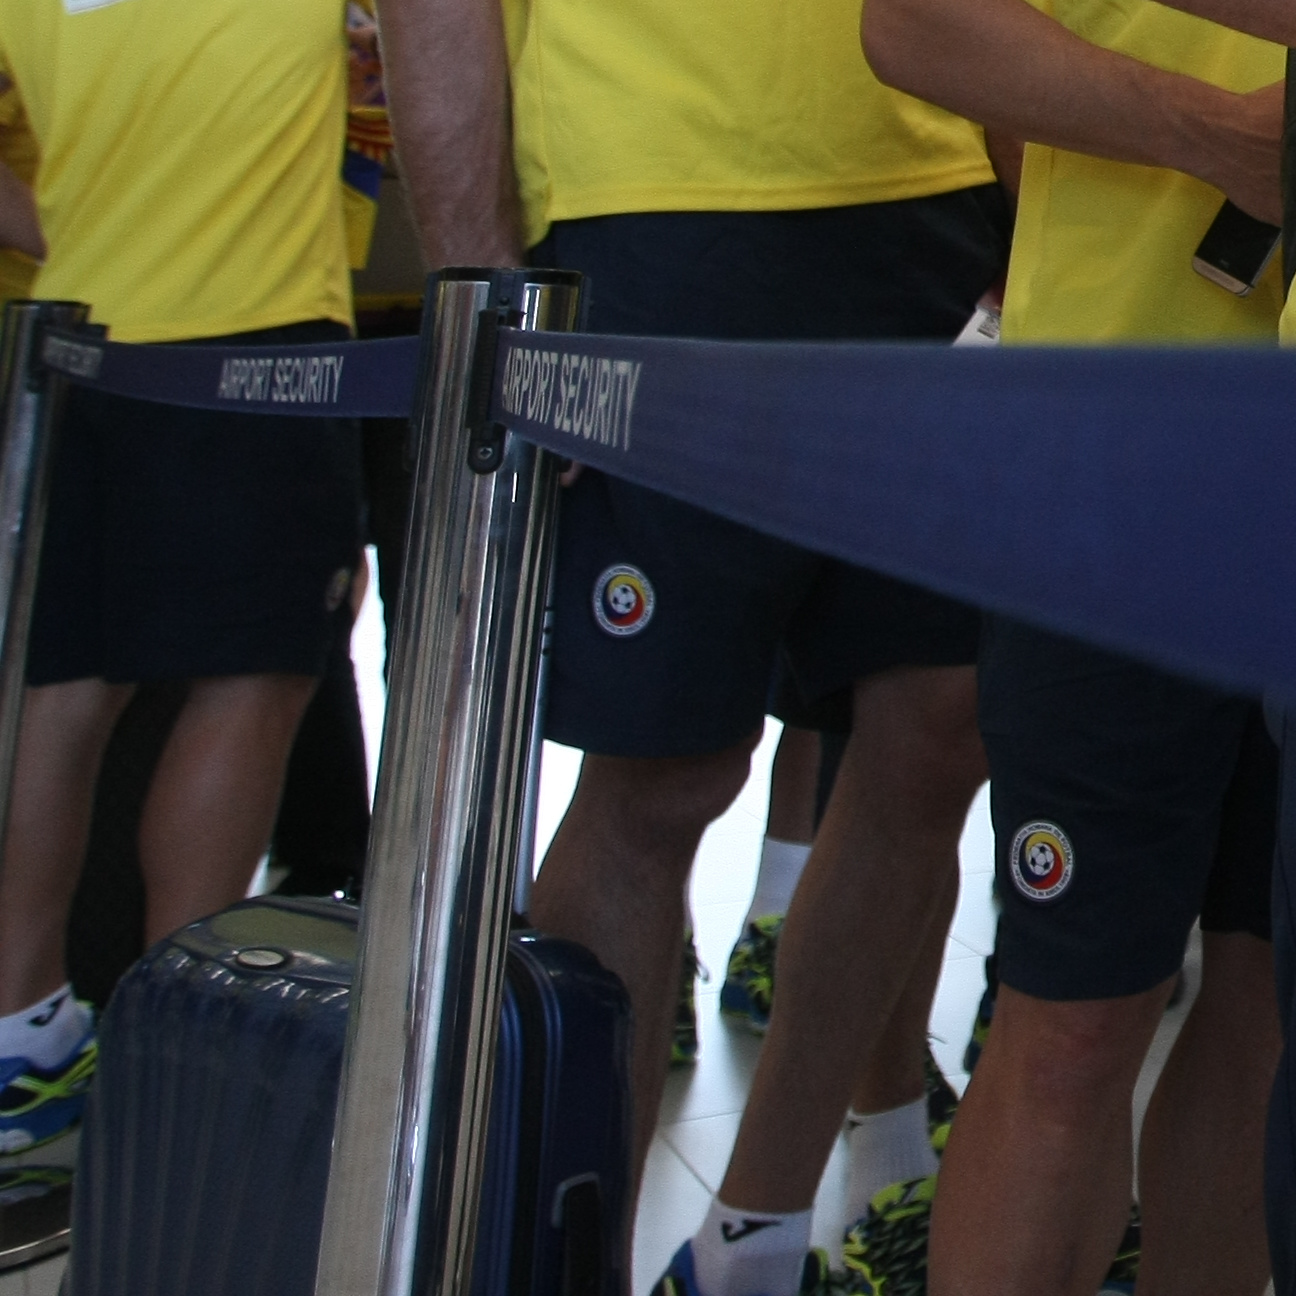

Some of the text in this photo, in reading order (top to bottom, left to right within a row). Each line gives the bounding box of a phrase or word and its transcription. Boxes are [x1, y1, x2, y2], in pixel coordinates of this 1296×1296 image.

[219, 356, 344, 403] AIRPORT SECURITY
[502, 347, 643, 452] AIRPORT SECURITY
